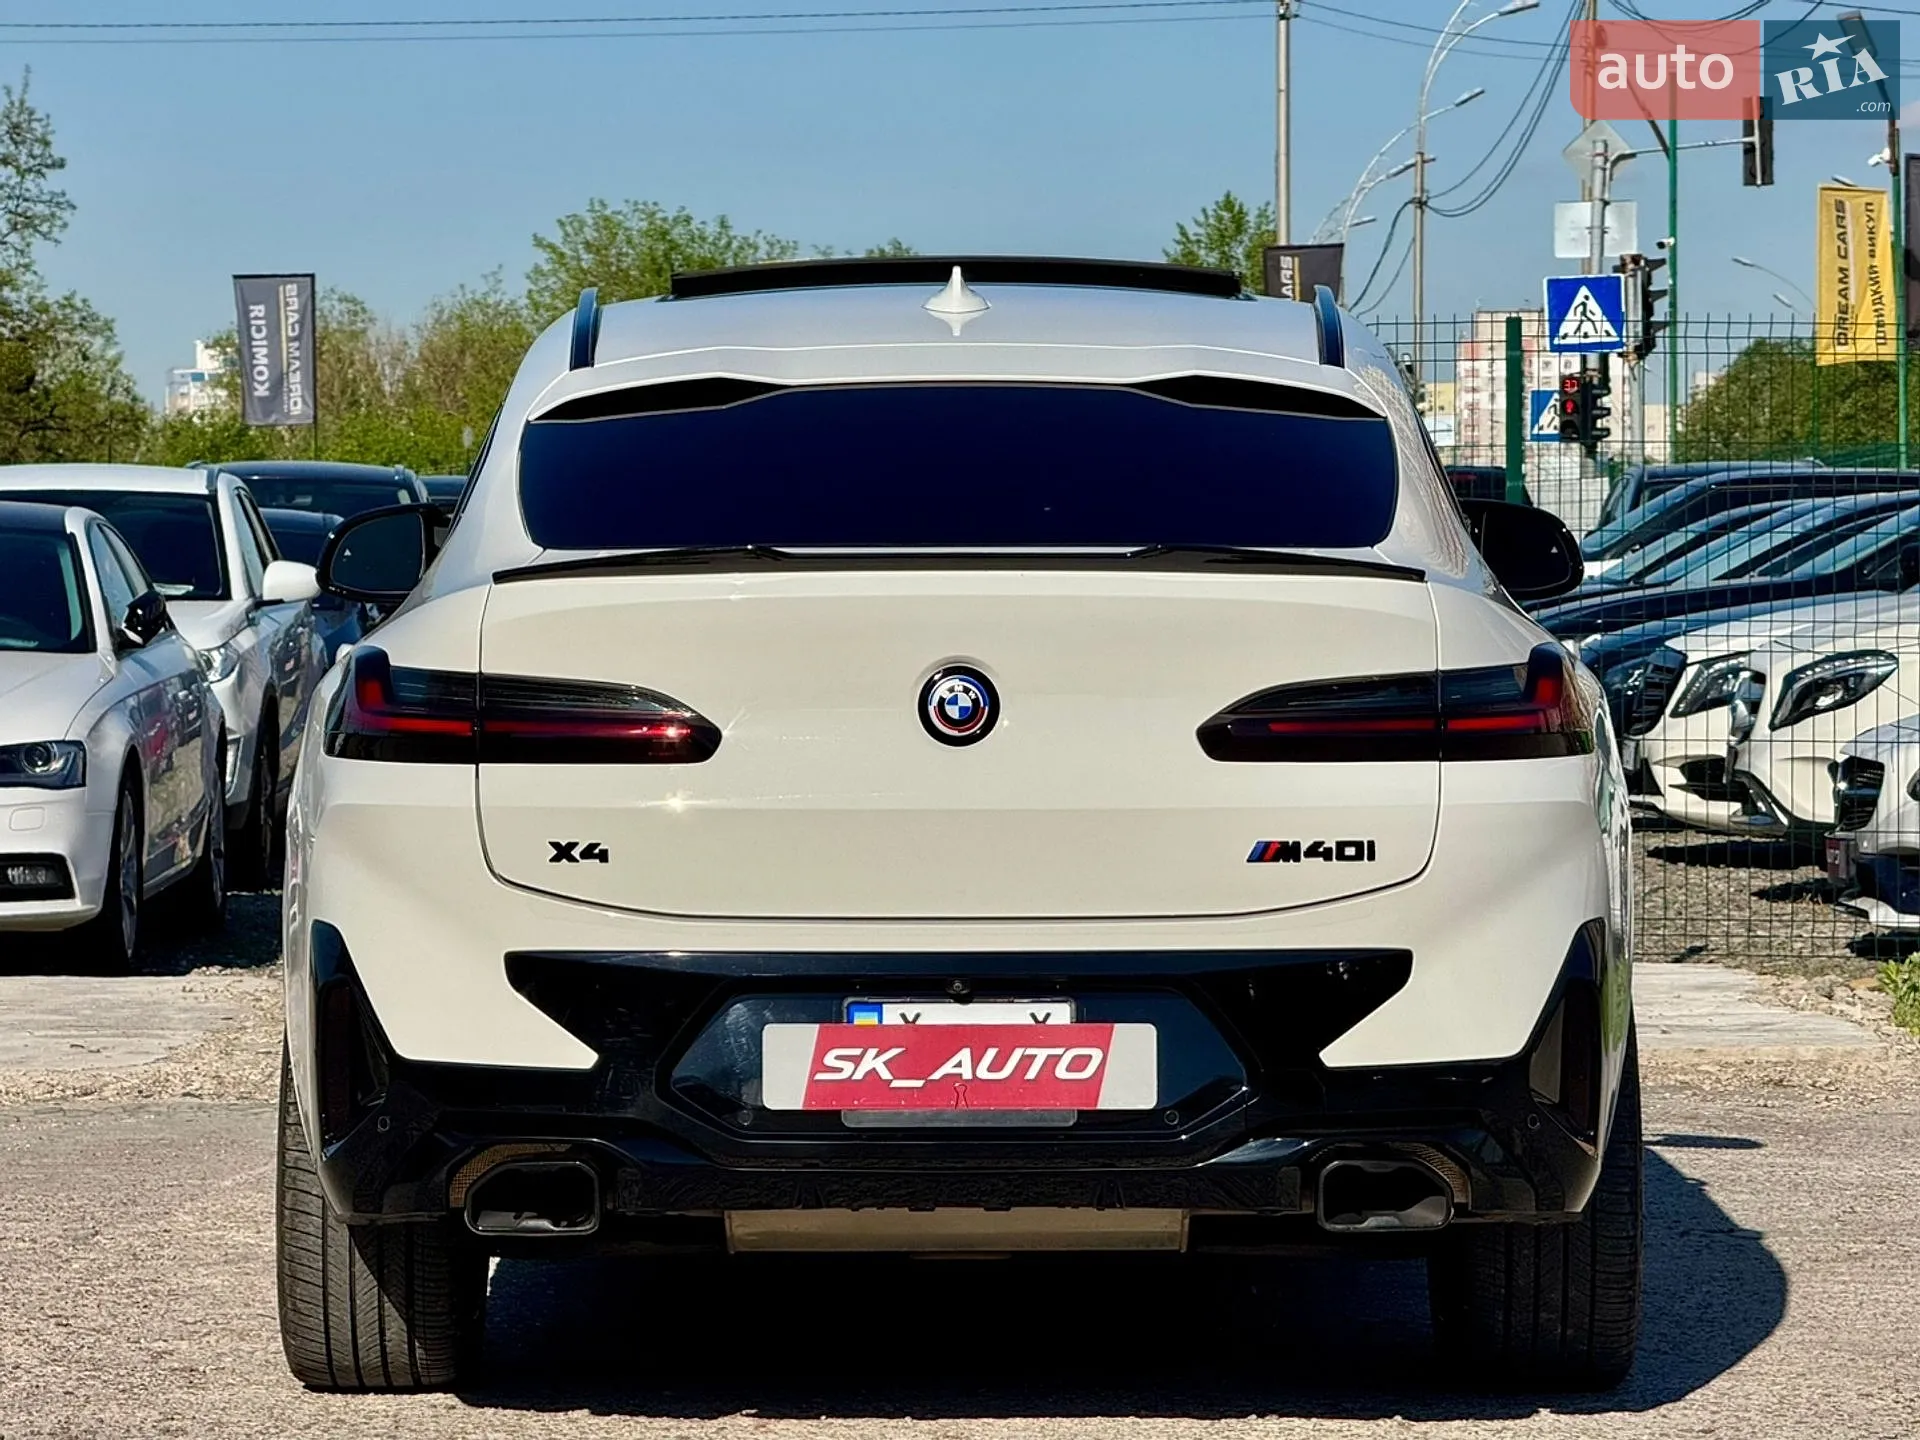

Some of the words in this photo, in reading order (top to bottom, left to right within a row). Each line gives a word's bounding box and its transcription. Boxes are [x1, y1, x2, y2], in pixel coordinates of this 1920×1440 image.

[1835, 199, 1849, 259] CARS
[1836, 267, 1851, 346] DREAM
[548, 841, 609, 863] X4
[812, 1047, 1105, 1088] SK_AUTO
